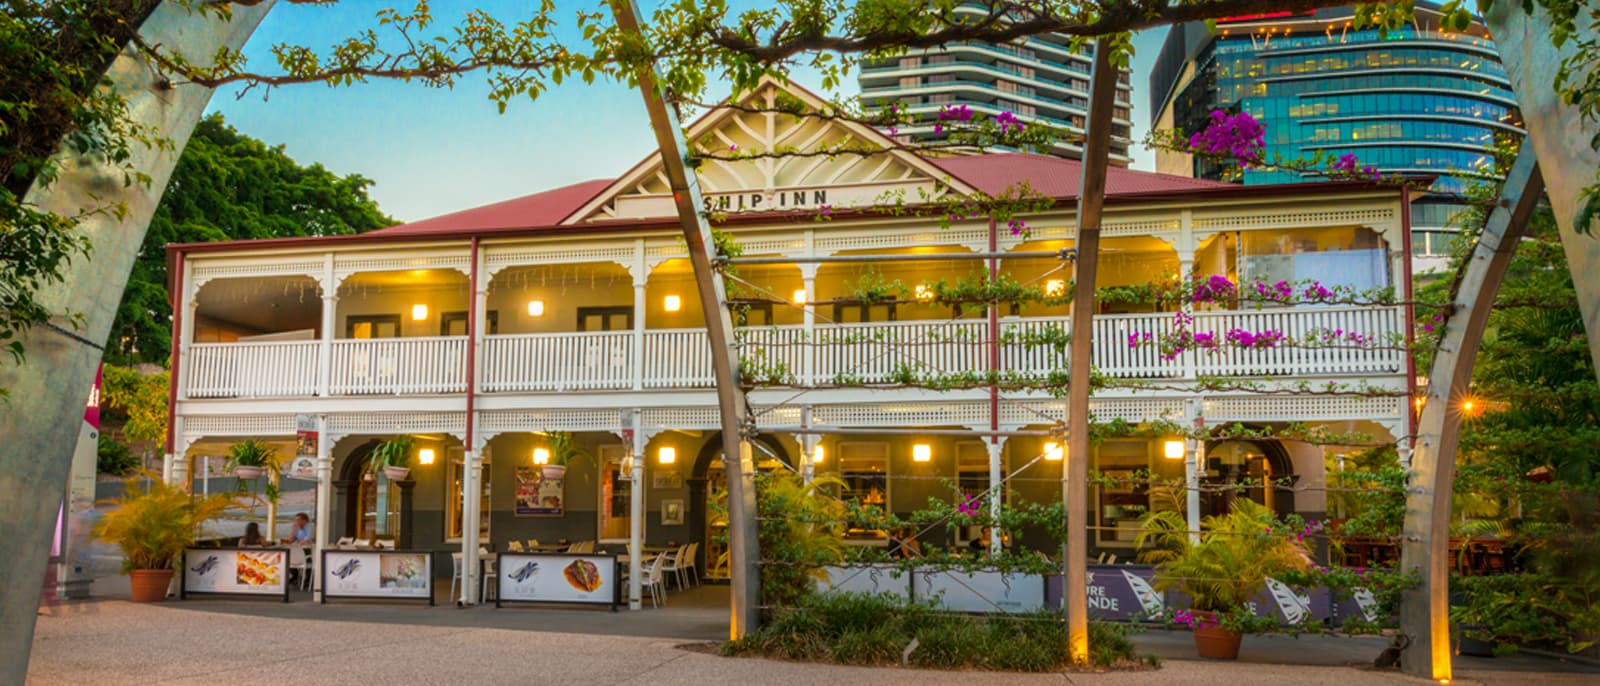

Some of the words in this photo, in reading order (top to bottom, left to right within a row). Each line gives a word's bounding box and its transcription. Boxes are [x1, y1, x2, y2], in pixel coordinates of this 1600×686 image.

[703, 194, 762, 211] SHIP
[780, 190, 827, 206] INN
[1088, 597, 1119, 612] NDE
